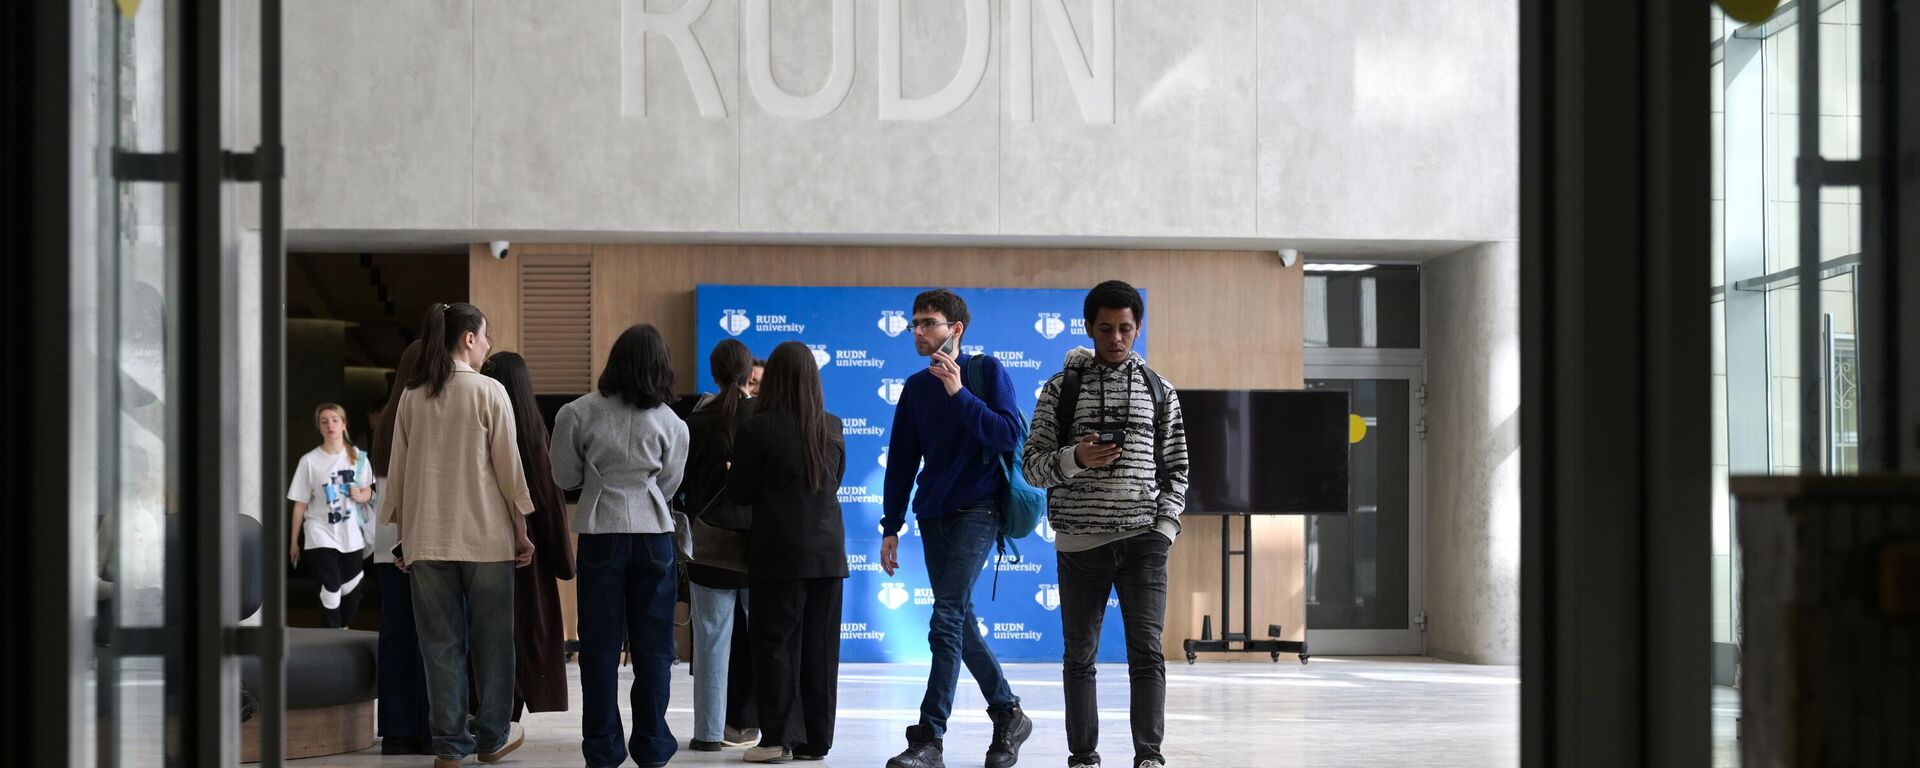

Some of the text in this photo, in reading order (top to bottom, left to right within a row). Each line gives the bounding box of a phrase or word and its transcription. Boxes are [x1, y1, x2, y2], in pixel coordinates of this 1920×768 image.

[621, 0, 1117, 124] RUDN
[756, 315, 787, 324] RUDN
[1070, 319, 1085, 327] RU
[756, 323, 804, 333] university
[836, 350, 867, 359] RUDN
[836, 358, 884, 368] university
[1002, 359, 1041, 369] niversity
[842, 418, 867, 427] UDN
[842, 426, 884, 436] niversity
[848, 562, 884, 572] iversity
[993, 623, 1024, 631] RUDN
[993, 630, 1041, 640] university
